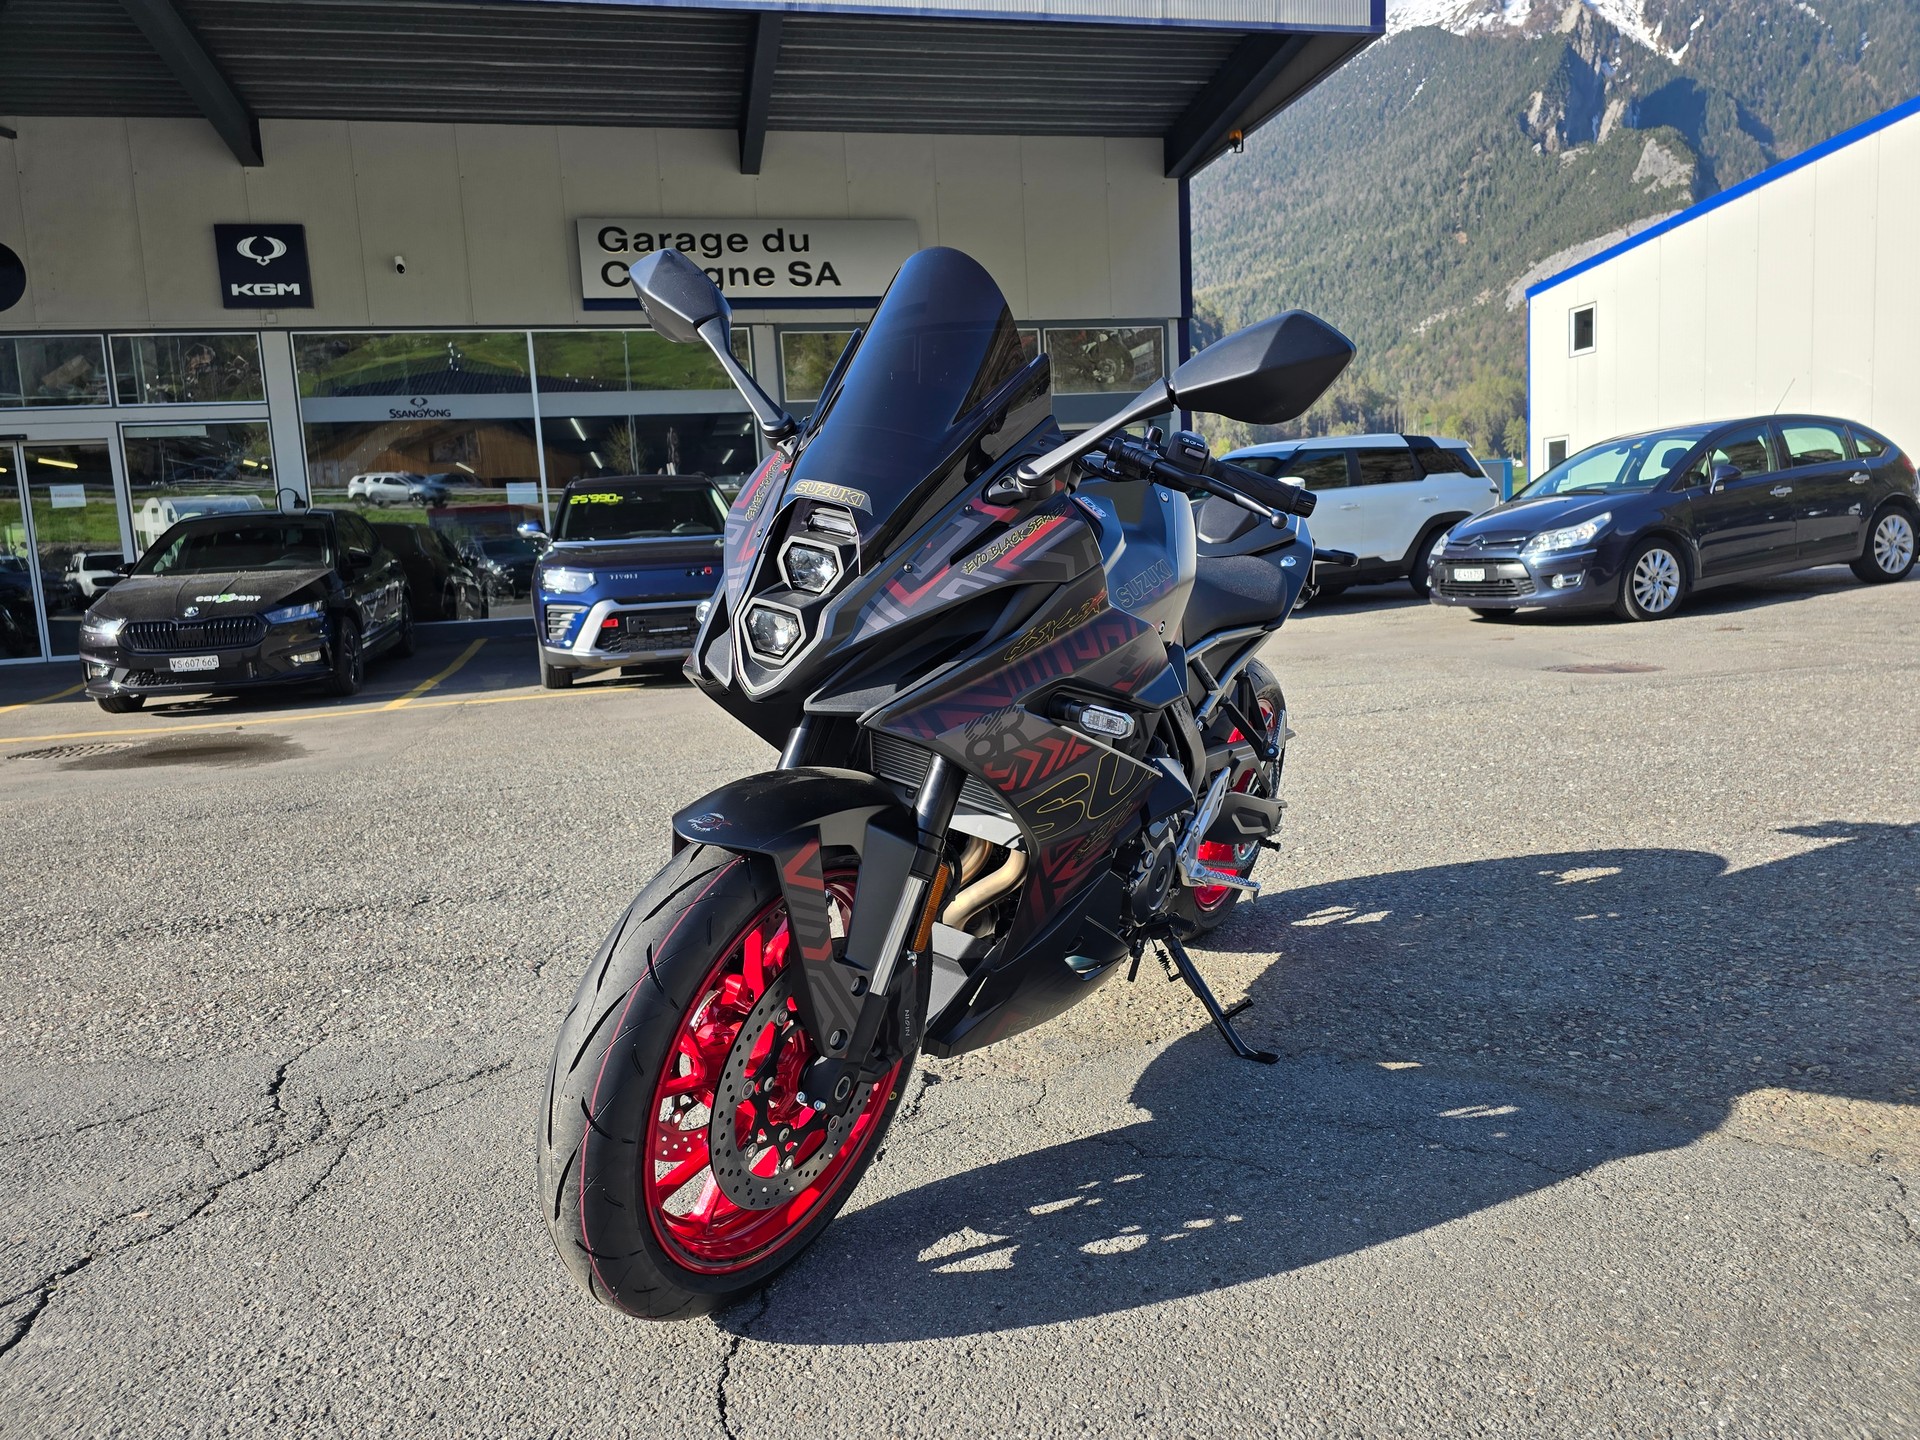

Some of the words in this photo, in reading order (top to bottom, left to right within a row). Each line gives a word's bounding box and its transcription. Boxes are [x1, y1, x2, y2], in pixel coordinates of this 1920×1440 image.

[597, 226, 749, 259] Garage
[762, 228, 810, 253] du
[231, 283, 301, 297] KGM
[601, 260, 776, 290] Cgne
[788, 261, 842, 287] SA
[795, 482, 864, 506] SUZUKI
[961, 552, 988, 575] EVO
[989, 529, 1028, 562] BLACK
[1027, 504, 1068, 537] SERIES
[1115, 558, 1175, 610] SUZUKI
